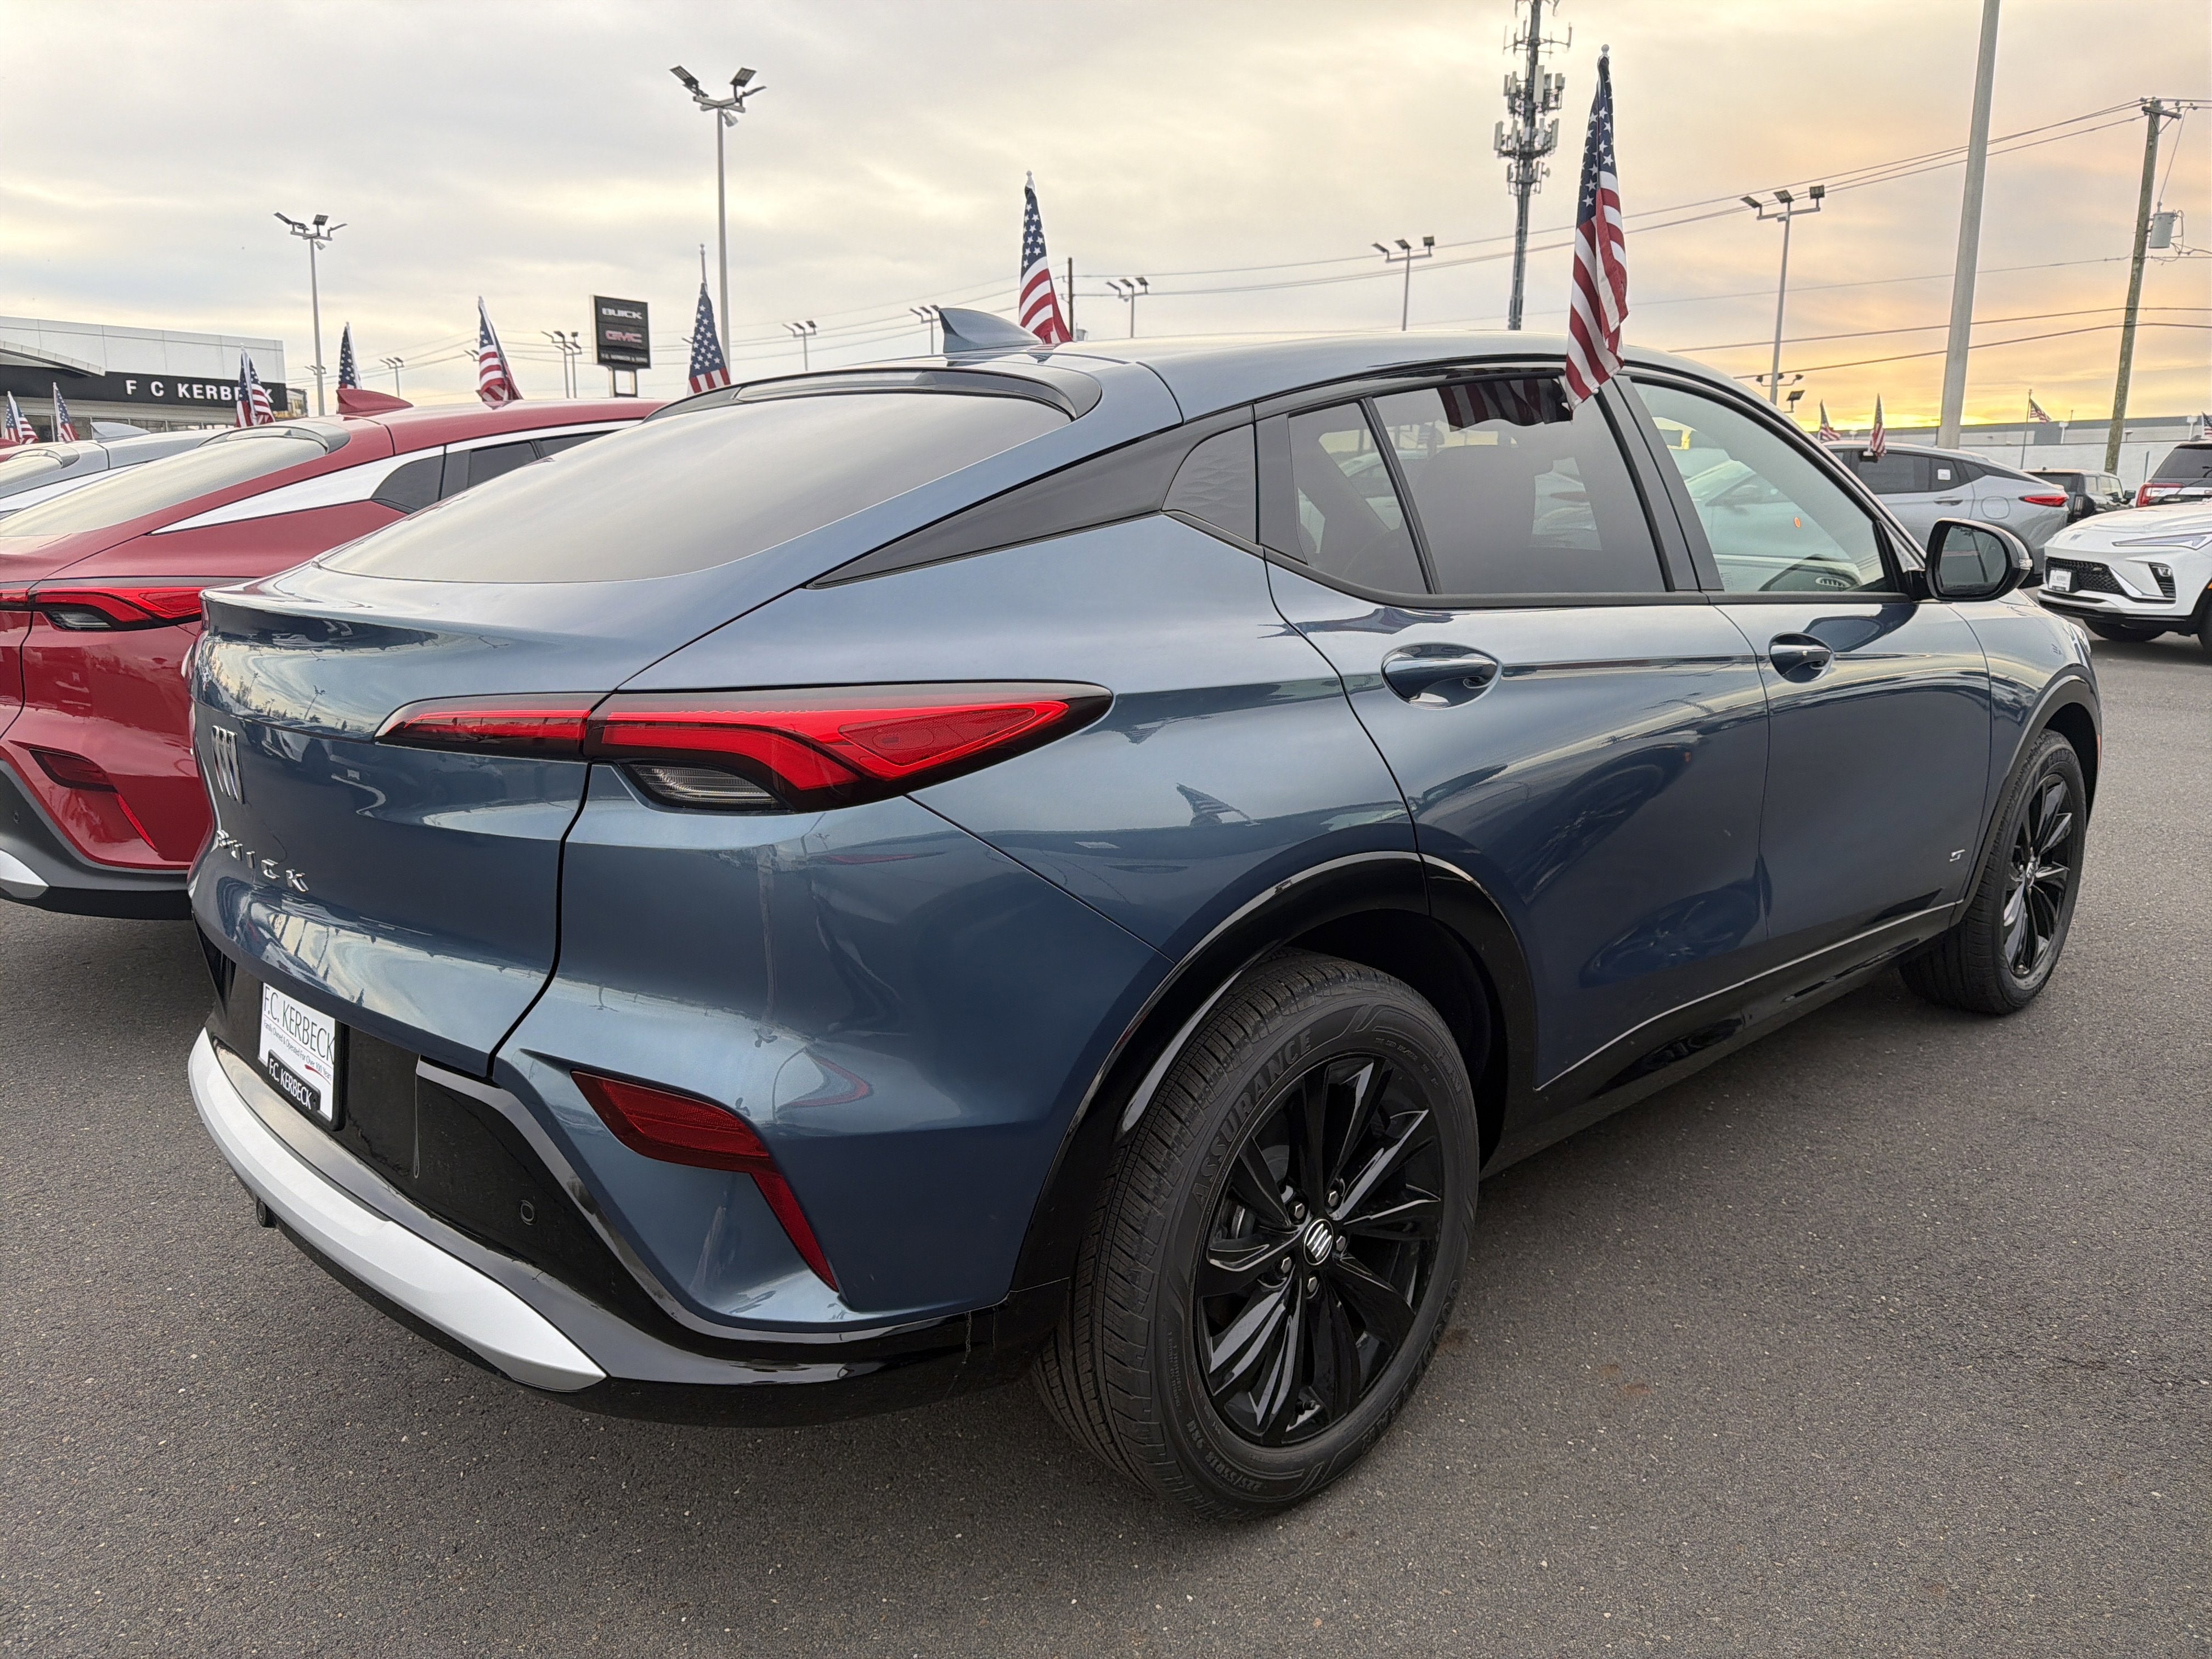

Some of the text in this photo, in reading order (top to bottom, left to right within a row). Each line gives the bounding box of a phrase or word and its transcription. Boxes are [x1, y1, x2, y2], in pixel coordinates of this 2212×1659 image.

[602, 307, 642, 319] BUICK
[605, 330, 642, 343] GMC
[126, 380, 274, 403] F C KERBK
[217, 830, 309, 892] BUICK
[282, 1000, 335, 1065] KERBECK
[280, 1068, 313, 1110] KERBECK
[1192, 1028, 1312, 1209] ASSURANCE
